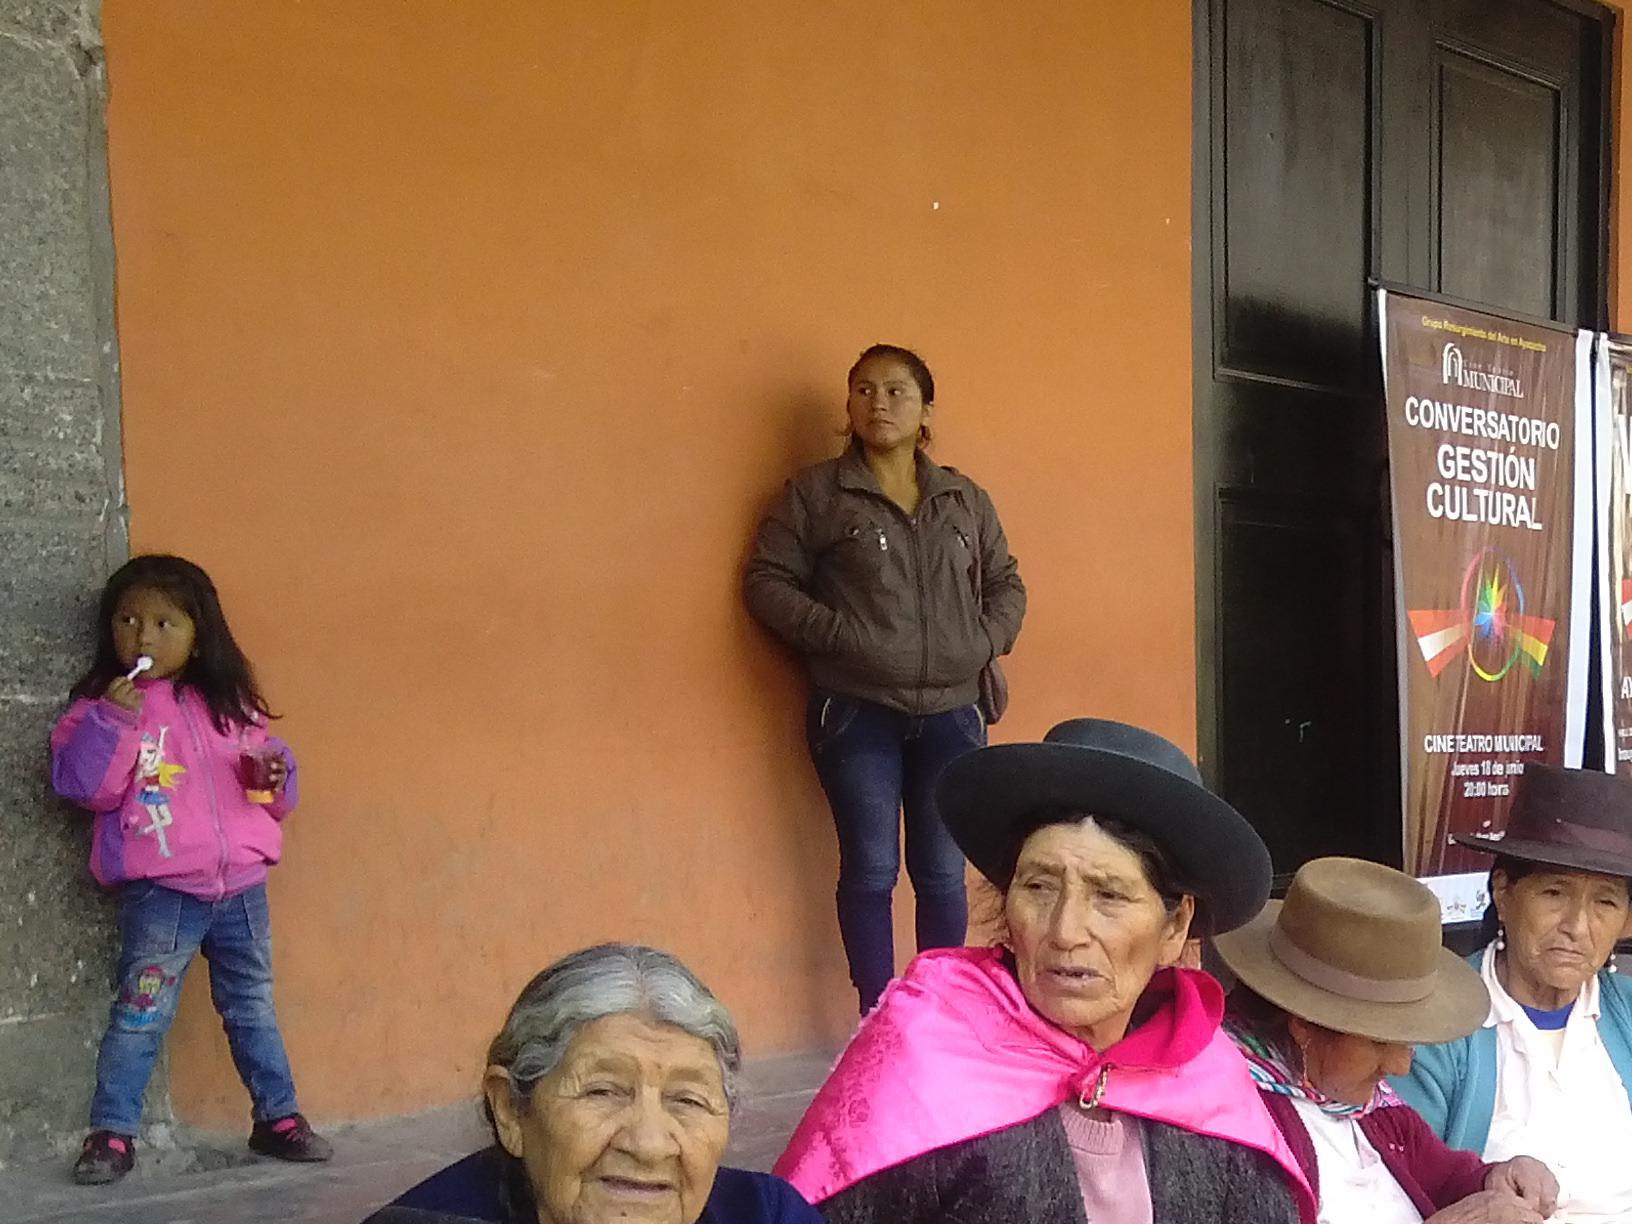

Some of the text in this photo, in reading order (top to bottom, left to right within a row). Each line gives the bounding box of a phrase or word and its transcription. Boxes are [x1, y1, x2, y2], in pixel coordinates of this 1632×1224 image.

[1463, 369, 1524, 399] MUNICIPAL
[1405, 396, 1560, 449] CONVERSATORIO
[1437, 443, 1536, 491] GESTIÓN
[1426, 482, 1543, 531] CULTURAL
[1424, 734, 1544, 753] CINE TEATRO MUNICIPAL
[1451, 761, 1480, 776] Jueves
[1491, 761, 1504, 776] de
